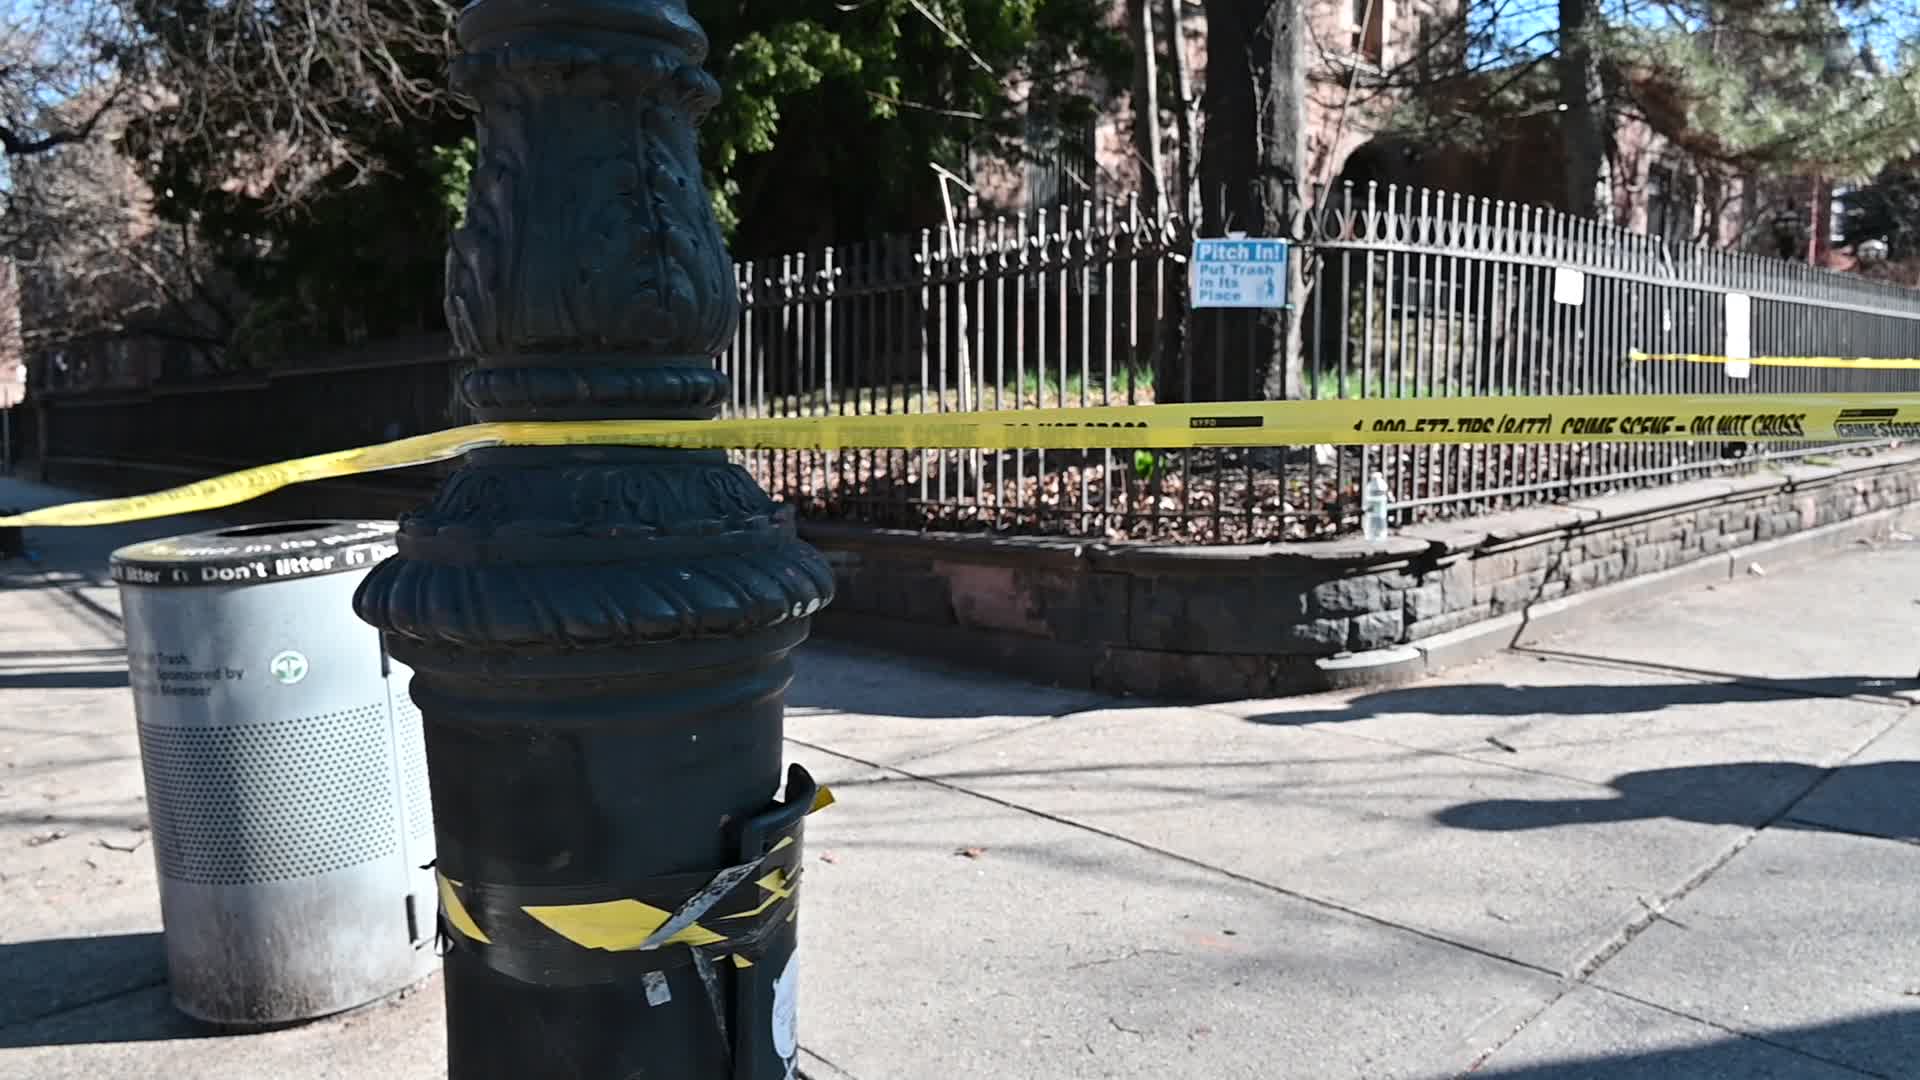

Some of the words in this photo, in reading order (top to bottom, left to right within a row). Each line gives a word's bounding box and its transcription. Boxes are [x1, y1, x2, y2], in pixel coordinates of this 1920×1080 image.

[1200, 243, 1249, 260] Pitch
[1256, 243, 1280, 260] In!
[1200, 263, 1225, 275] Put
[1231, 263, 1274, 275] Trash
[1200, 290, 1241, 301] Place
[1752, 413, 1806, 437] CROSS
[202, 561, 268, 581] Don't
[275, 555, 334, 576] litter
[225, 667, 244, 681] by
